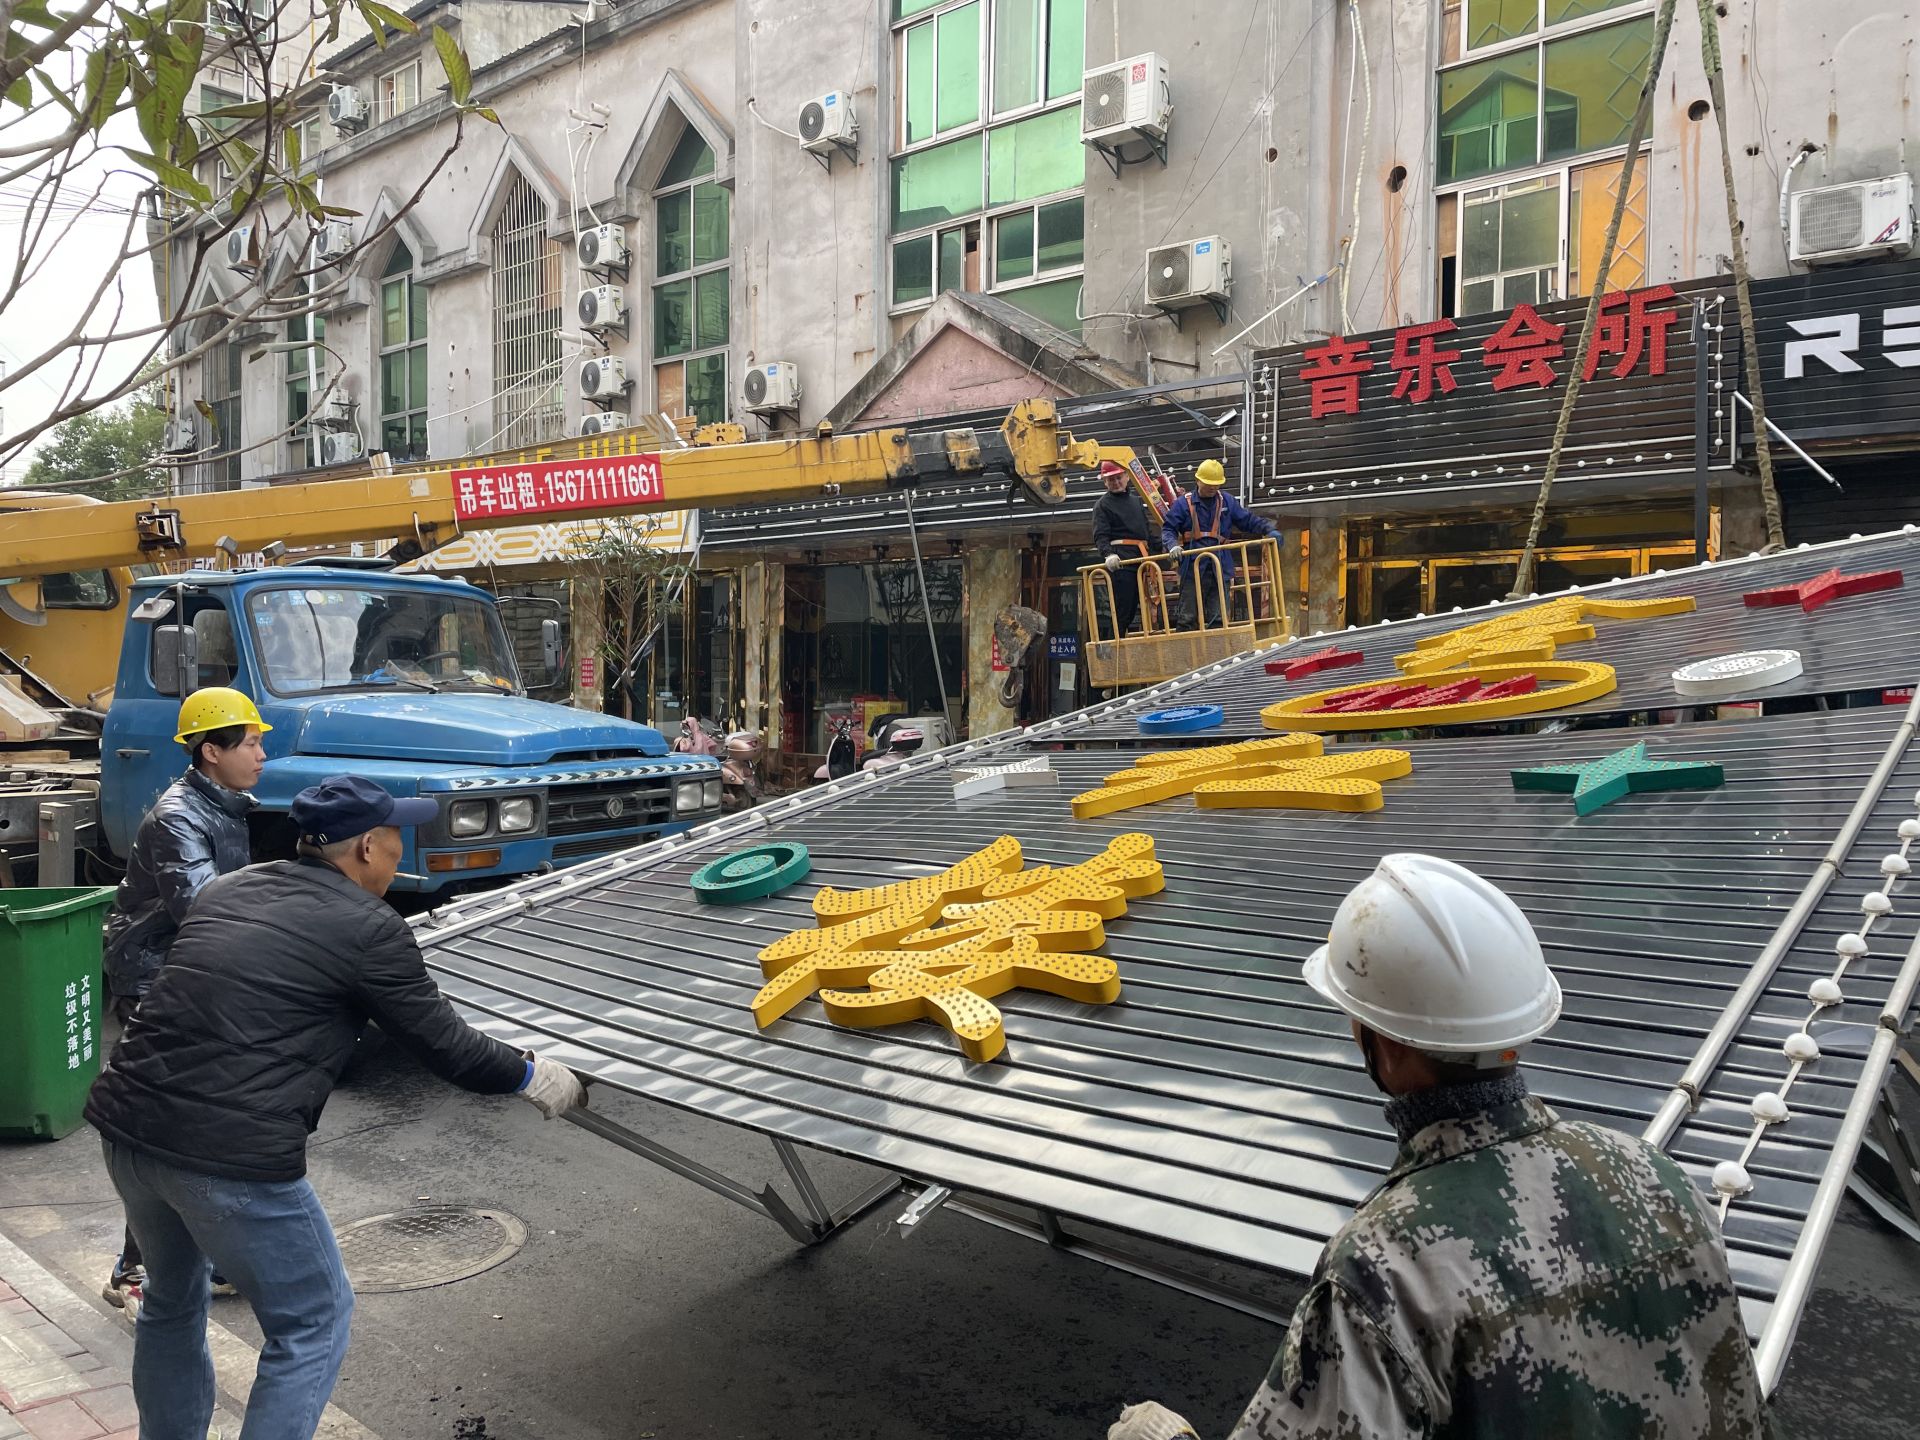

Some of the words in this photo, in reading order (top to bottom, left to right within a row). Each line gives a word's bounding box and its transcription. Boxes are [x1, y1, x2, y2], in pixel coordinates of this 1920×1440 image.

[1299, 284, 1679, 419] 音乐会所
[1050, 645, 1077, 654] 禁止入内
[65, 981, 80, 1070] 垃圾不落地
[81, 974, 92, 1062] 文明又美丽
